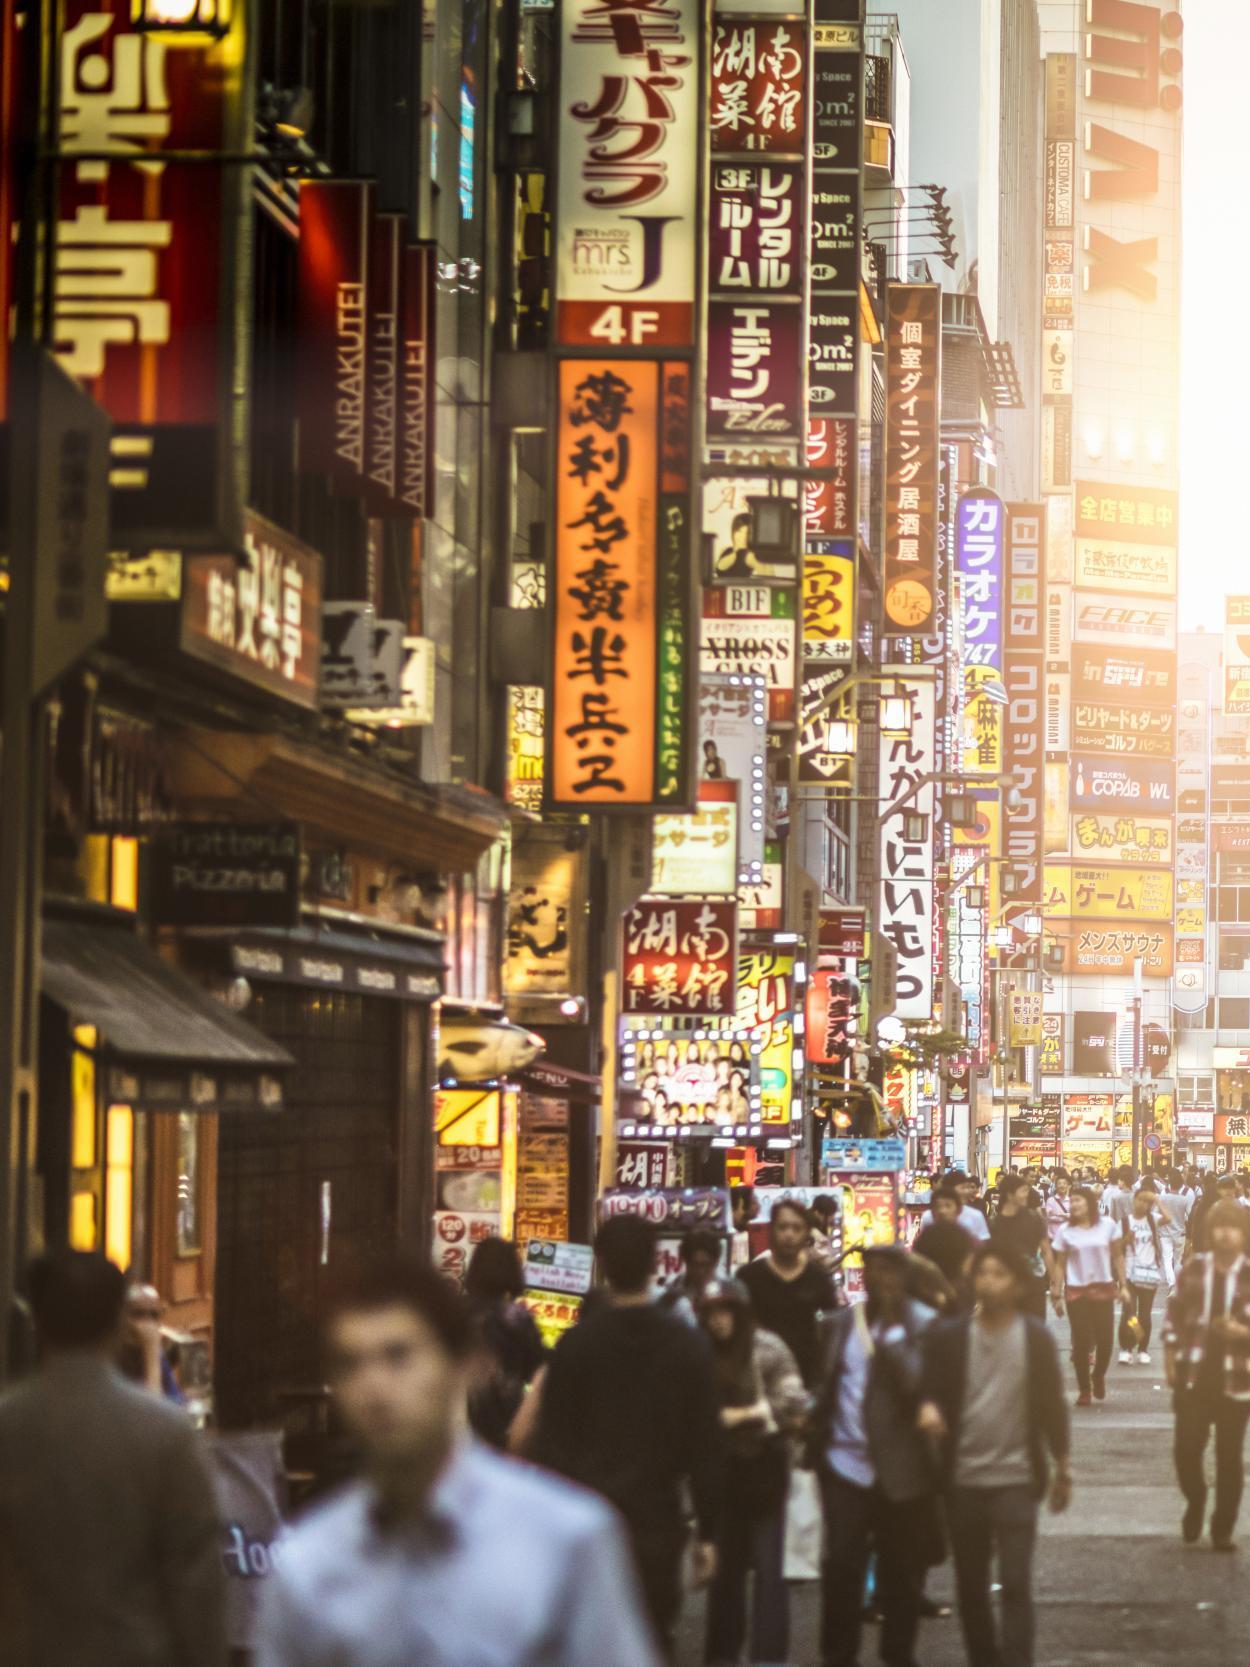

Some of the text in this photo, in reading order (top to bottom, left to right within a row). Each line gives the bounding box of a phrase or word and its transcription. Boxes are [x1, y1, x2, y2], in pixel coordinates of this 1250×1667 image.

[740, 133, 772, 150] 4F
[719, 168, 752, 189] 3F
[820, 193, 850, 204] Space
[758, 167, 793, 288] レンタル
[601, 215, 684, 293] J
[718, 197, 752, 288] ルーム
[812, 265, 829, 279] 4F
[1046, 274, 1072, 290] 免税
[589, 304, 660, 345] 4F
[819, 314, 850, 327] Space
[730, 308, 772, 399] エデン
[337, 282, 364, 474] ANRAKUTEI
[811, 389, 828, 400] 3F
[723, 402, 792, 432] Eden
[896, 321, 924, 563] 個室ダイニング居酒屋
[1080, 495, 1174, 529] 全店営業中
[963, 500, 998, 640] カラオケ
[730, 588, 768, 612] B1F
[1078, 605, 1173, 627] FACE
[977, 700, 998, 766] 麻雀
[1075, 705, 1173, 733] ビリヤード&ダーツ
[1105, 734, 1136, 751] ゴルフ
[1075, 815, 1170, 849] まんが喫茶
[1075, 882, 1137, 910] ゲーム
[1077, 930, 1165, 954] メンズサウナ
[1066, 1114, 1112, 1133] ゲーム
